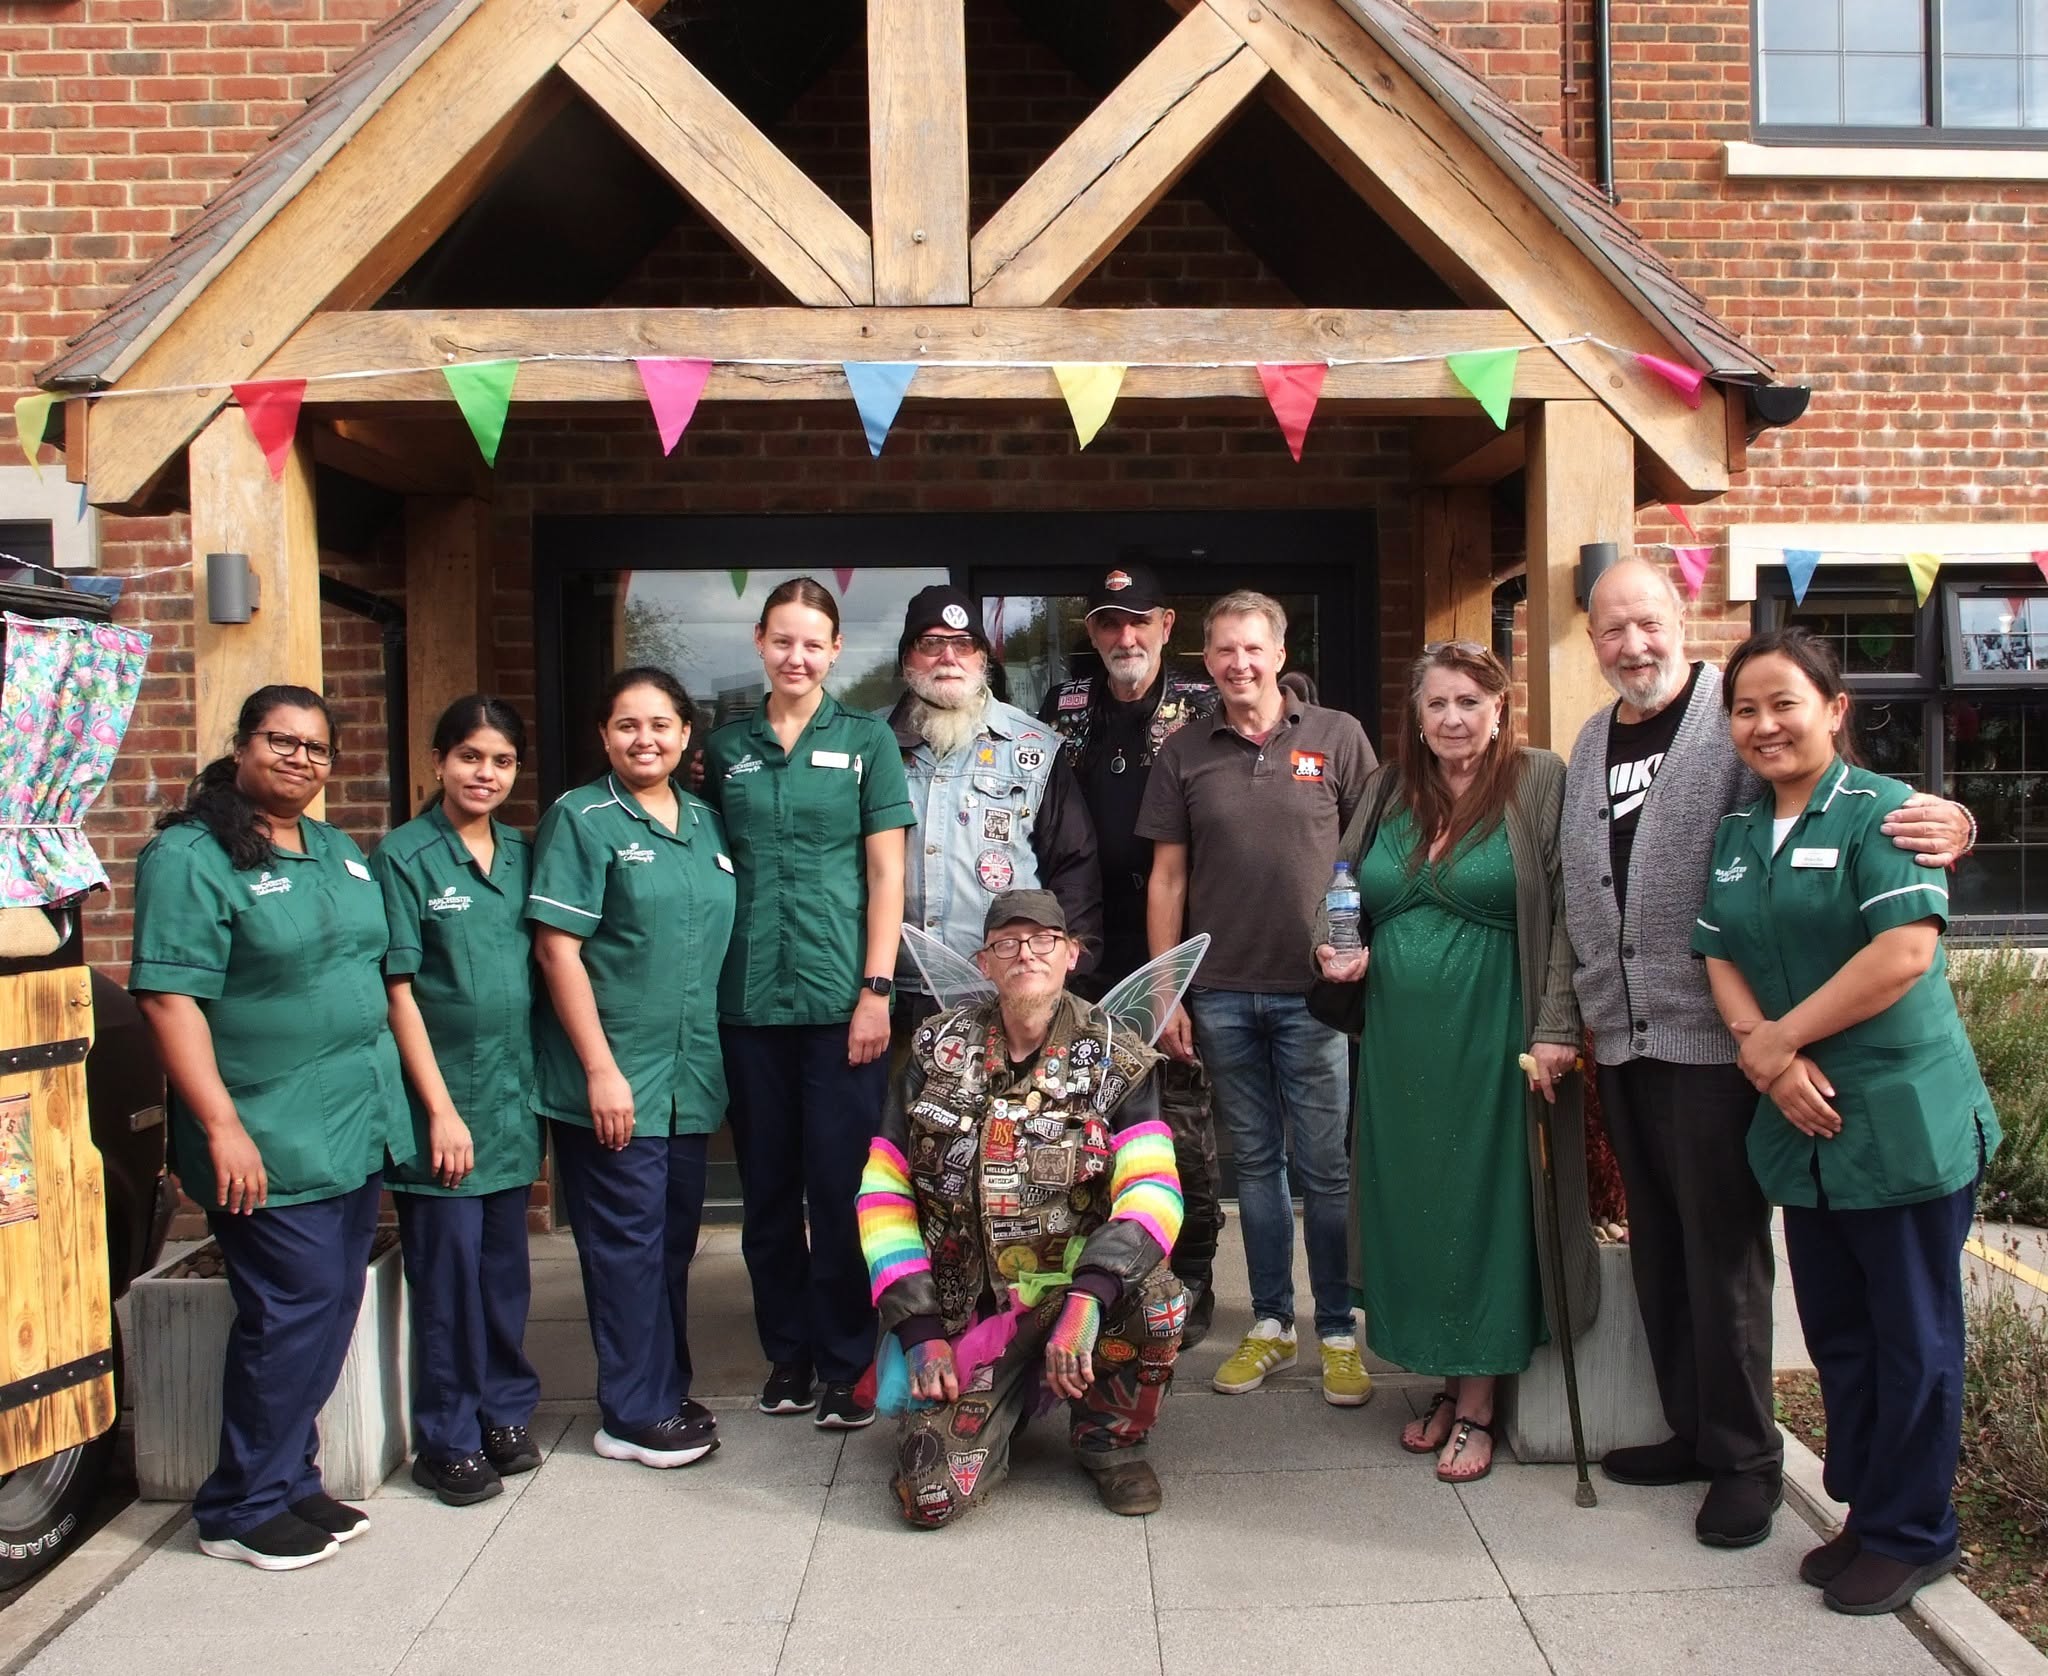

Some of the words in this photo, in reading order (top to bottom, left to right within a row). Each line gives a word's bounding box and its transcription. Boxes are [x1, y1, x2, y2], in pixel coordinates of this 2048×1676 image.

[1018, 753, 1040, 765] 69
[1070, 1039, 1101, 1054] MEMENTO
[1071, 1056, 1096, 1066] MORI
[992, 1121, 1014, 1146] BS
